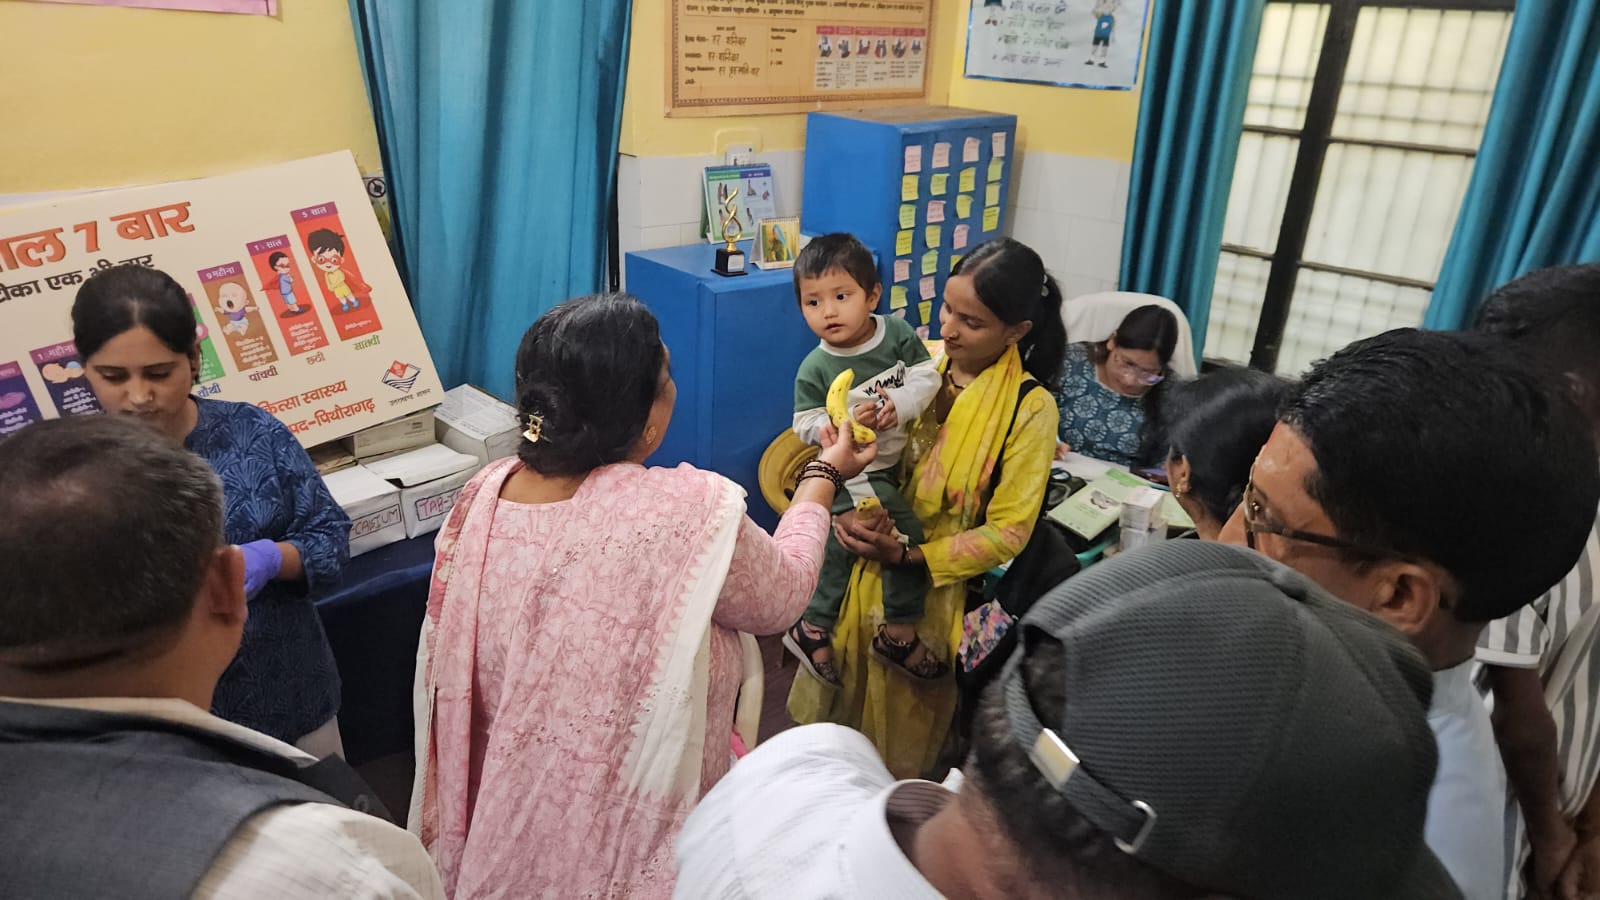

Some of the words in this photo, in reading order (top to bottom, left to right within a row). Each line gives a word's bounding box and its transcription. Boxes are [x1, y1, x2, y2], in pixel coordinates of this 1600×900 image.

[310, 206, 329, 217] साल
[0, 227, 66, 272] ाल
[73, 220, 101, 253] 7
[109, 201, 195, 240] बार
[44, 270, 83, 290] एक
[300, 380, 348, 404] स्वास्थ्य
